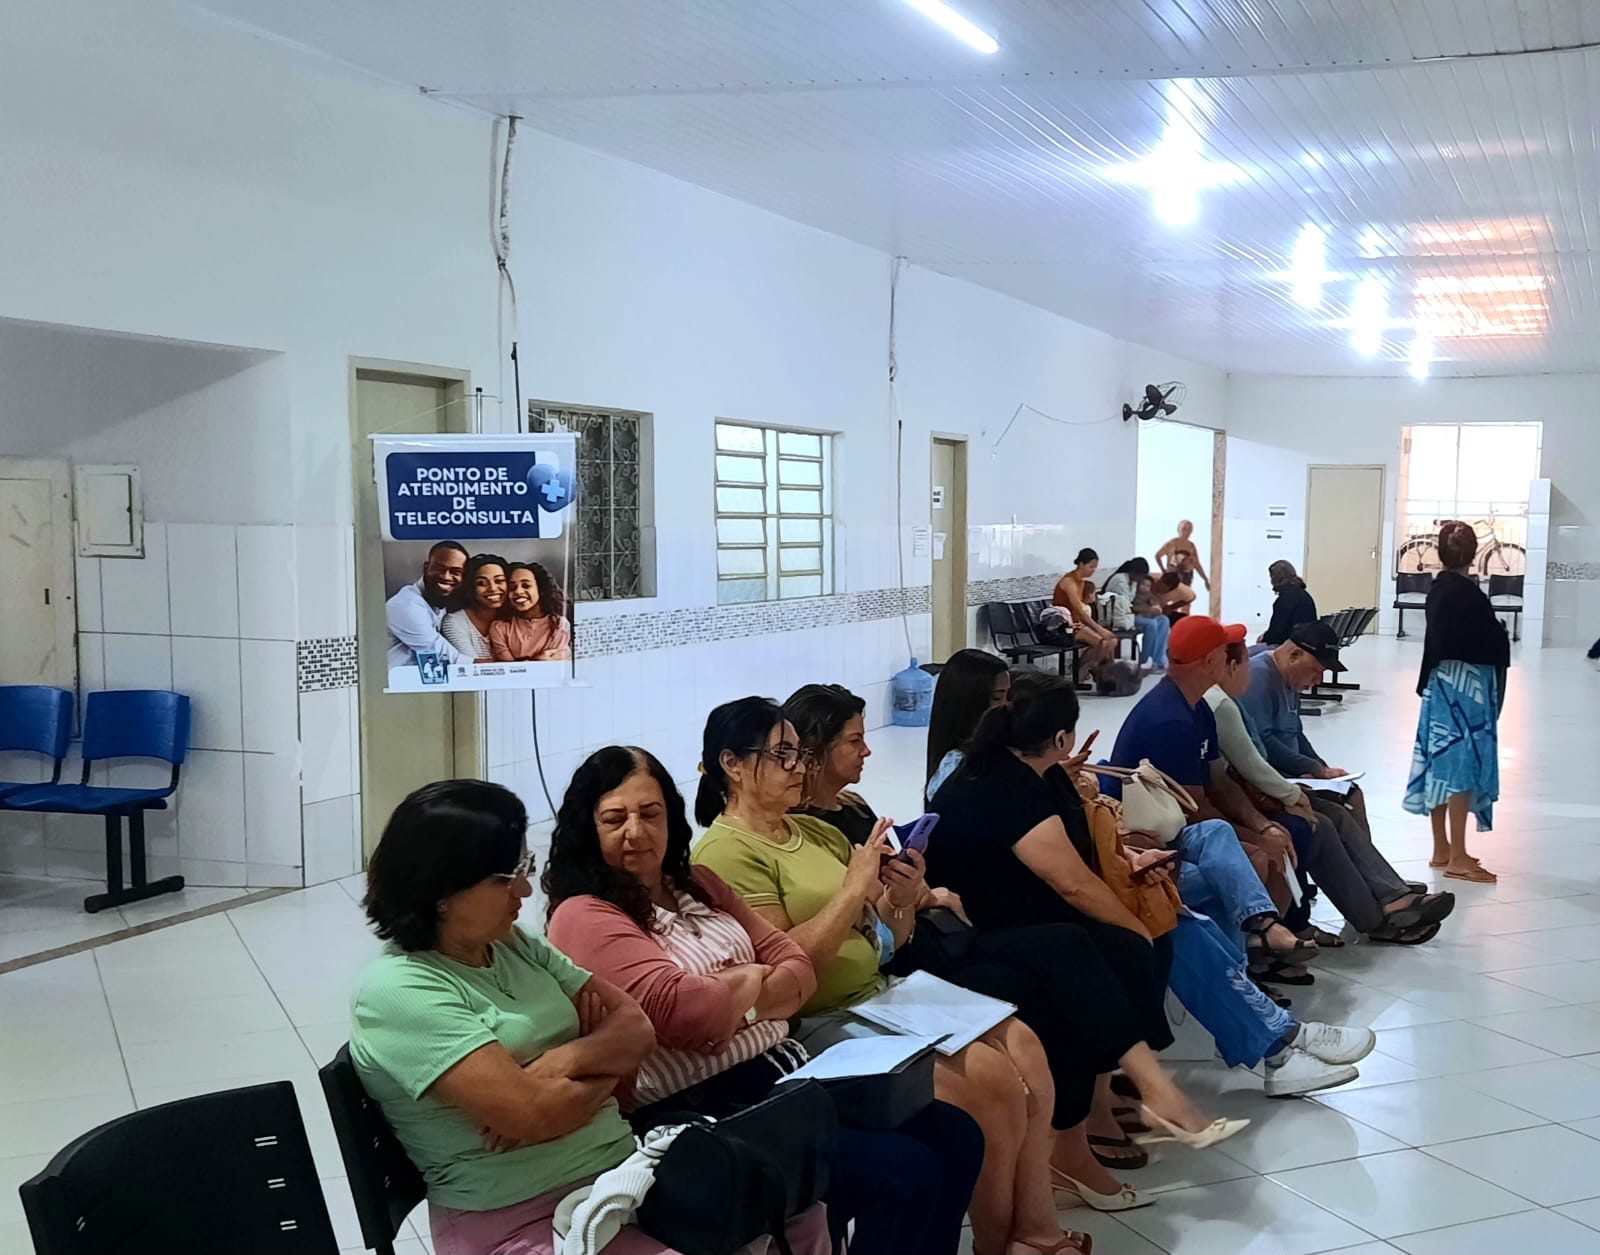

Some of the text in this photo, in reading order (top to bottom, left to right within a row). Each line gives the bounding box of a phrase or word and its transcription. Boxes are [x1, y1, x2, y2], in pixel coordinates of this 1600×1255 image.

[416, 467, 508, 481] PONTO DE
[398, 482, 528, 496] ATENDIMENTO
[453, 497, 476, 510] DE
[395, 511, 534, 525] TELECONSULTA
